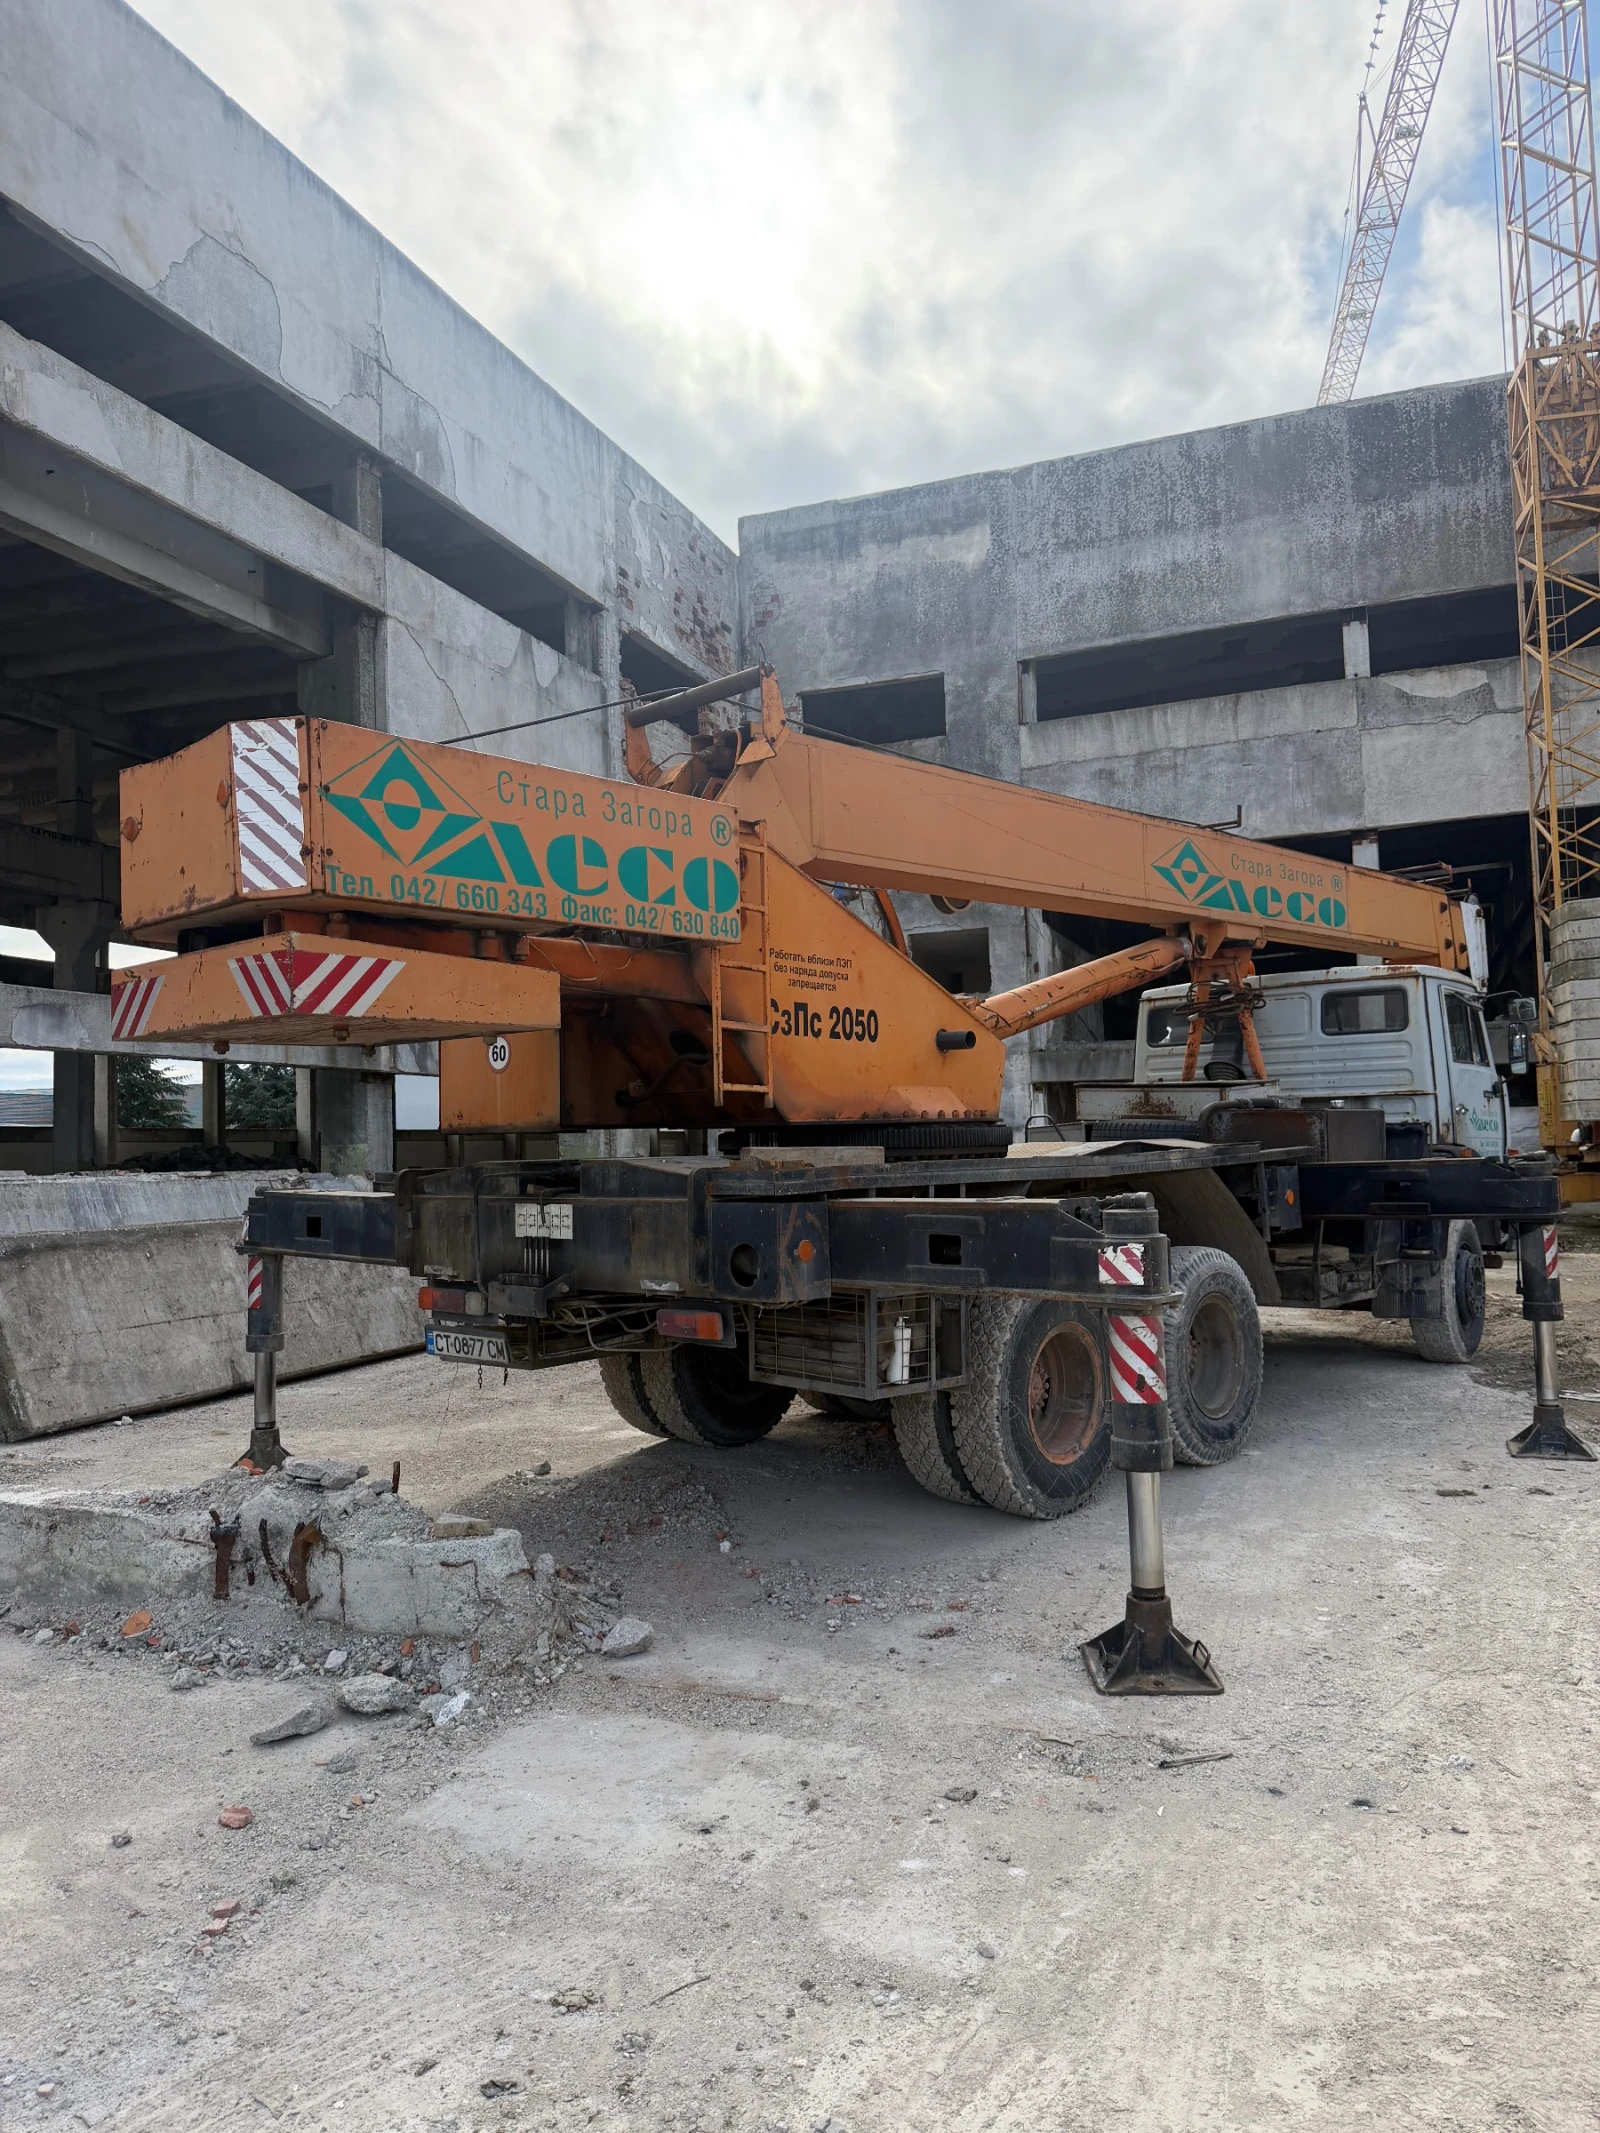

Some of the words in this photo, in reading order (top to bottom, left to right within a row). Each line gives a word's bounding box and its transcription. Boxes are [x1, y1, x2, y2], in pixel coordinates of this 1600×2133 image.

[497, 770, 587, 820] Стара
[601, 791, 693, 839] Загора
[1231, 853, 1272, 879] Стара
[1279, 863, 1324, 888] Загора
[325, 864, 382, 898] Тел.
[390, 873, 447, 908] 042/
[456, 882, 499, 912] 660
[507, 889, 548, 918] 343
[560, 894, 618, 926] Факс:
[625, 904, 667, 933] 042/
[672, 910, 704, 935] 630
[709, 915, 740, 939] 840
[769, 947, 805, 963] Работать
[807, 954, 834, 967] вблизи
[836, 957, 852, 969] ЛЭП
[773, 962, 788, 973] без
[789, 966, 817, 978] наряда
[819, 970, 849, 981] допуска
[787, 978, 837, 992] запрещается
[829, 1005, 879, 1043] 2050
[492, 1044, 506, 1062] 60
[453, 1336, 484, 1357] 0877
